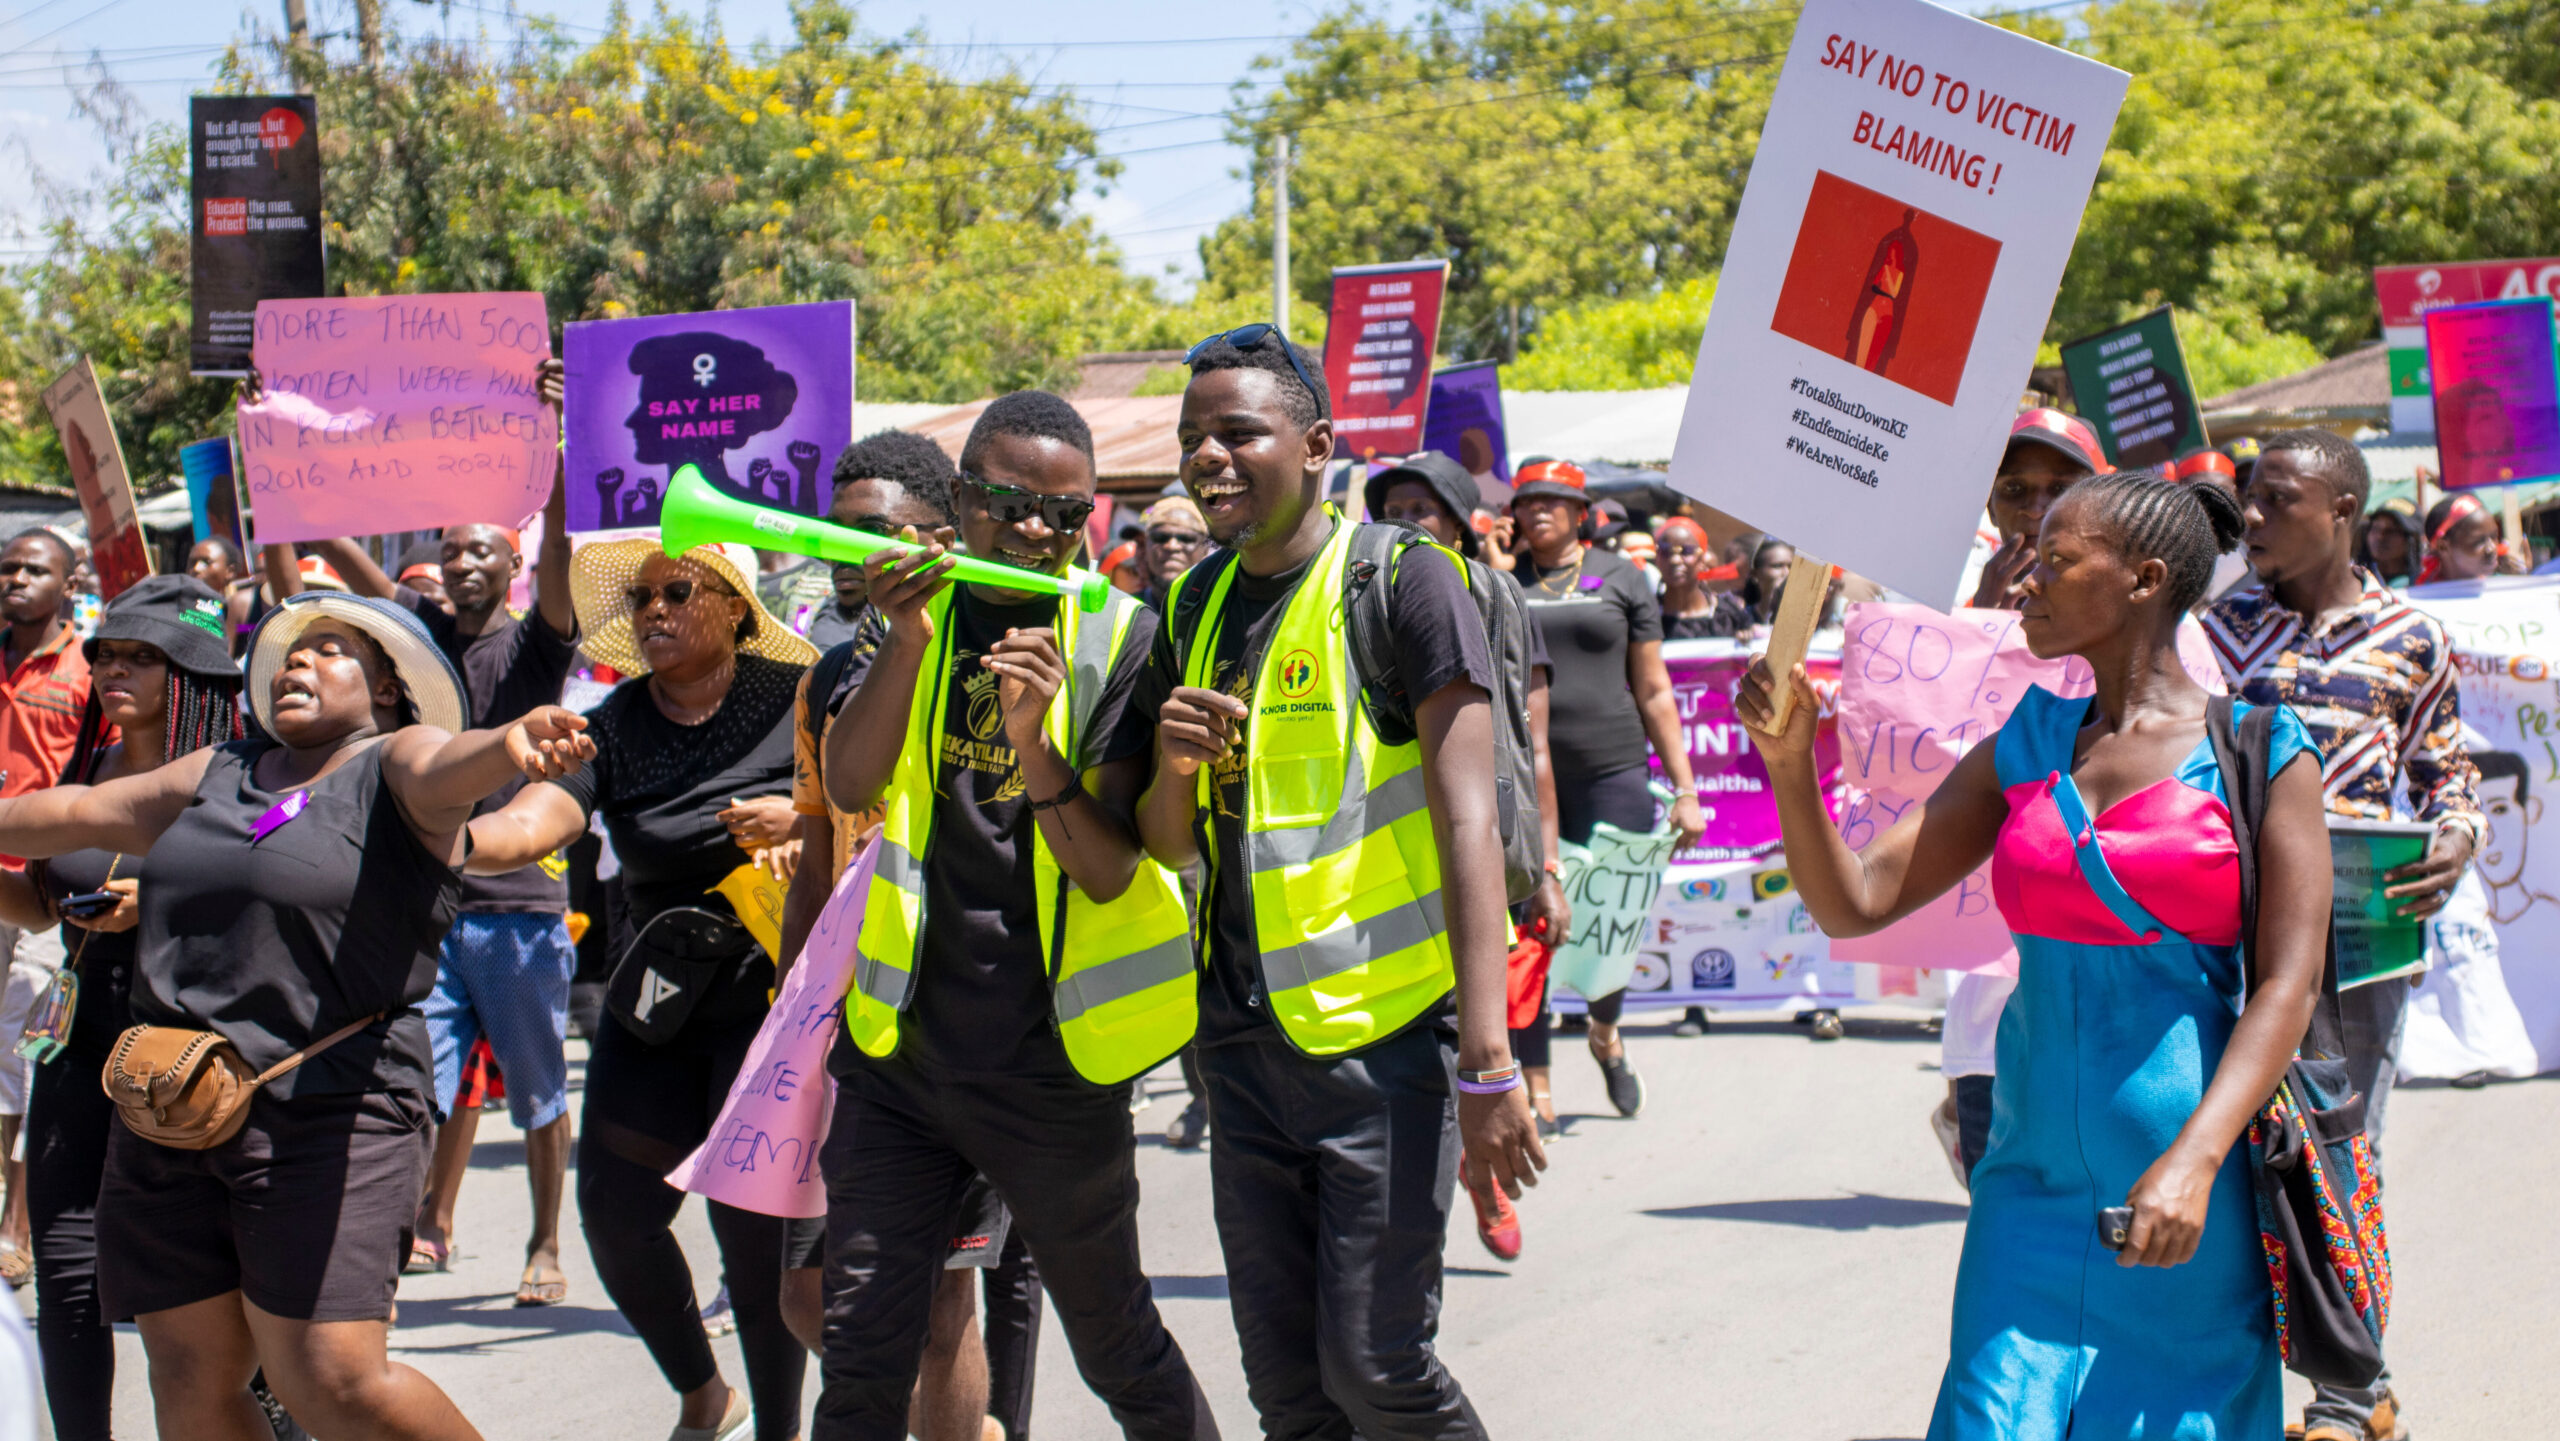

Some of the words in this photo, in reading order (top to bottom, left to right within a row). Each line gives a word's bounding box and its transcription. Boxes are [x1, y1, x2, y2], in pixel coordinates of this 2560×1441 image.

[1820, 33, 1878, 79] SAY
[1878, 54, 1925, 97] NO
[1931, 72, 1969, 114] TO
[1976, 89, 2076, 157] VICTIM
[205, 121, 224, 136] Not
[226, 120, 237, 135] all
[240, 121, 264, 133] men,
[267, 118, 285, 132] but
[206, 138, 241, 153] enough
[245, 136, 259, 149] for
[262, 137, 274, 148] us
[277, 135, 289, 148] to
[1852, 110, 1986, 188] BLAMING
[206, 153, 218, 168] be
[221, 152, 256, 167] scared.
[207, 201, 245, 215] Educate
[249, 200, 265, 213] the
[268, 201, 293, 213] men.
[207, 217, 245, 231] Protect
[247, 216, 263, 230] the
[266, 217, 307, 230] women.
[254, 308, 347, 345] MORE
[377, 303, 461, 342] THAN
[478, 307, 541, 353] 500
[399, 365, 472, 393] WERE
[486, 366, 538, 397] KILL
[648, 398, 700, 417] SAY
[709, 394, 761, 413] HER
[1790, 376, 1909, 439] #TotalShutDownKE
[244, 416, 273, 452] IN
[297, 411, 403, 450] KENYA
[430, 404, 551, 442] BETWEEN
[661, 419, 735, 440] NAME
[1792, 407, 1889, 462] #EndfemicideKe
[252, 462, 325, 493] 2016
[348, 458, 412, 480] AND
[437, 452, 518, 481] 2024
[1786, 435, 1879, 488] #WeAreNotSafe
[1260, 704, 1287, 716] KNOB
[1290, 702, 1336, 713] DIGITAL
[944, 733, 1016, 767] EKATILILI
[1681, 724, 1750, 755] UNT
[1845, 719, 1985, 778] VICT
[988, 763, 1006, 776] FAIR
[1686, 847, 1731, 860] death
[2334, 866, 2355, 876] HEIR
[2336, 910, 2366, 920] WANGI
[705, 1118, 818, 1184] FEMI
